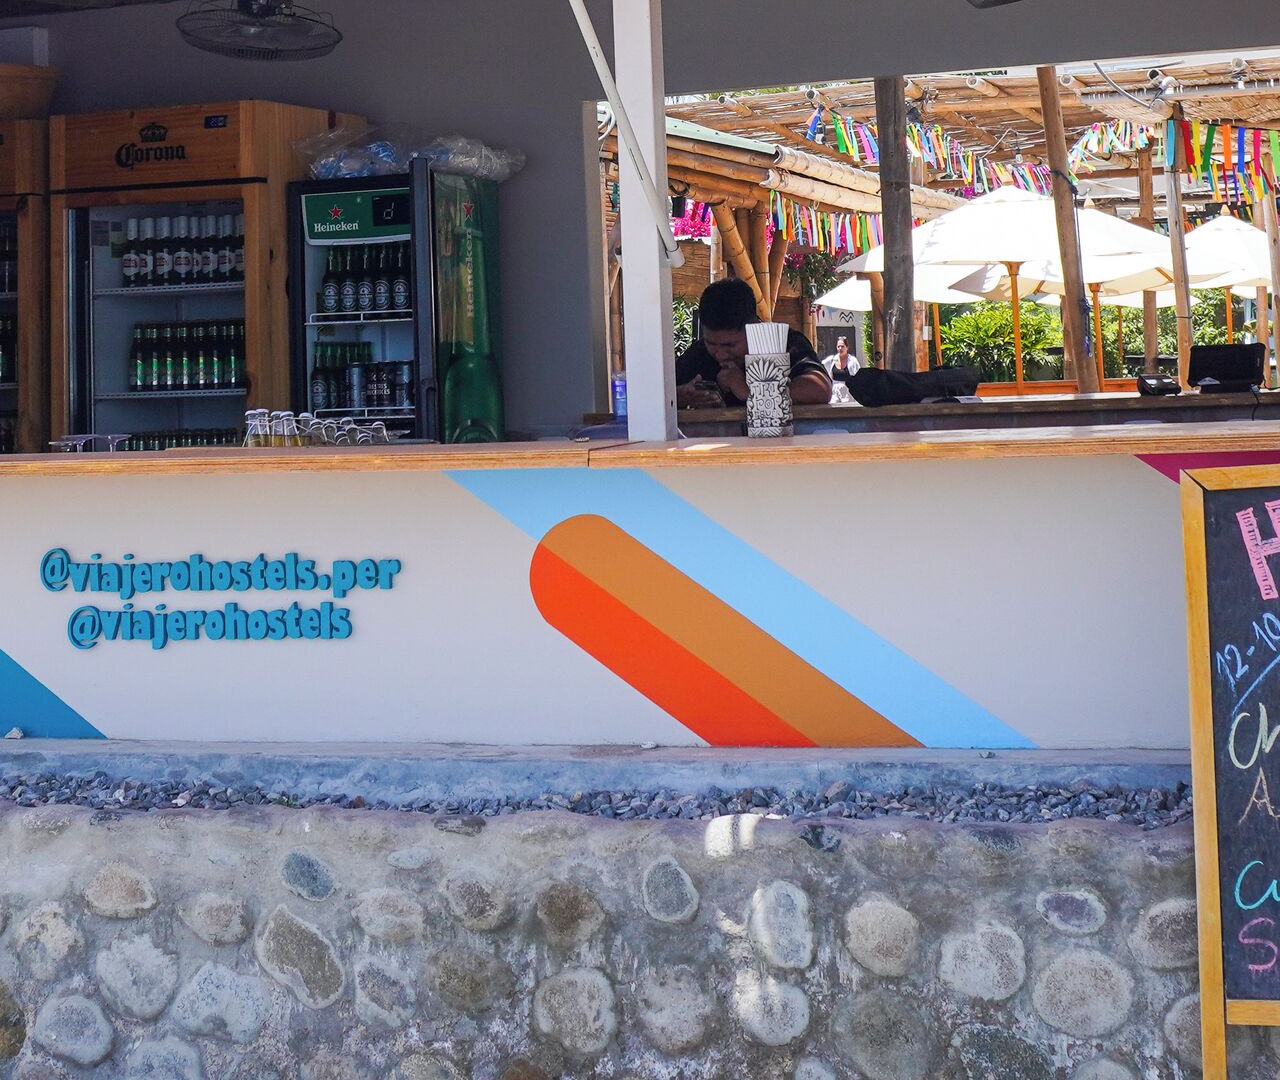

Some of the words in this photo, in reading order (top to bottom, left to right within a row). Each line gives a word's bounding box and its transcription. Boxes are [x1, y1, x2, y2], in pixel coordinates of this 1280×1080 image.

[115, 143, 187, 169] Corona
[314, 221, 359, 233] Heineken
[39, 547, 402, 600] @viajerohostels.per
[67, 601, 353, 650] @viajerohostels
